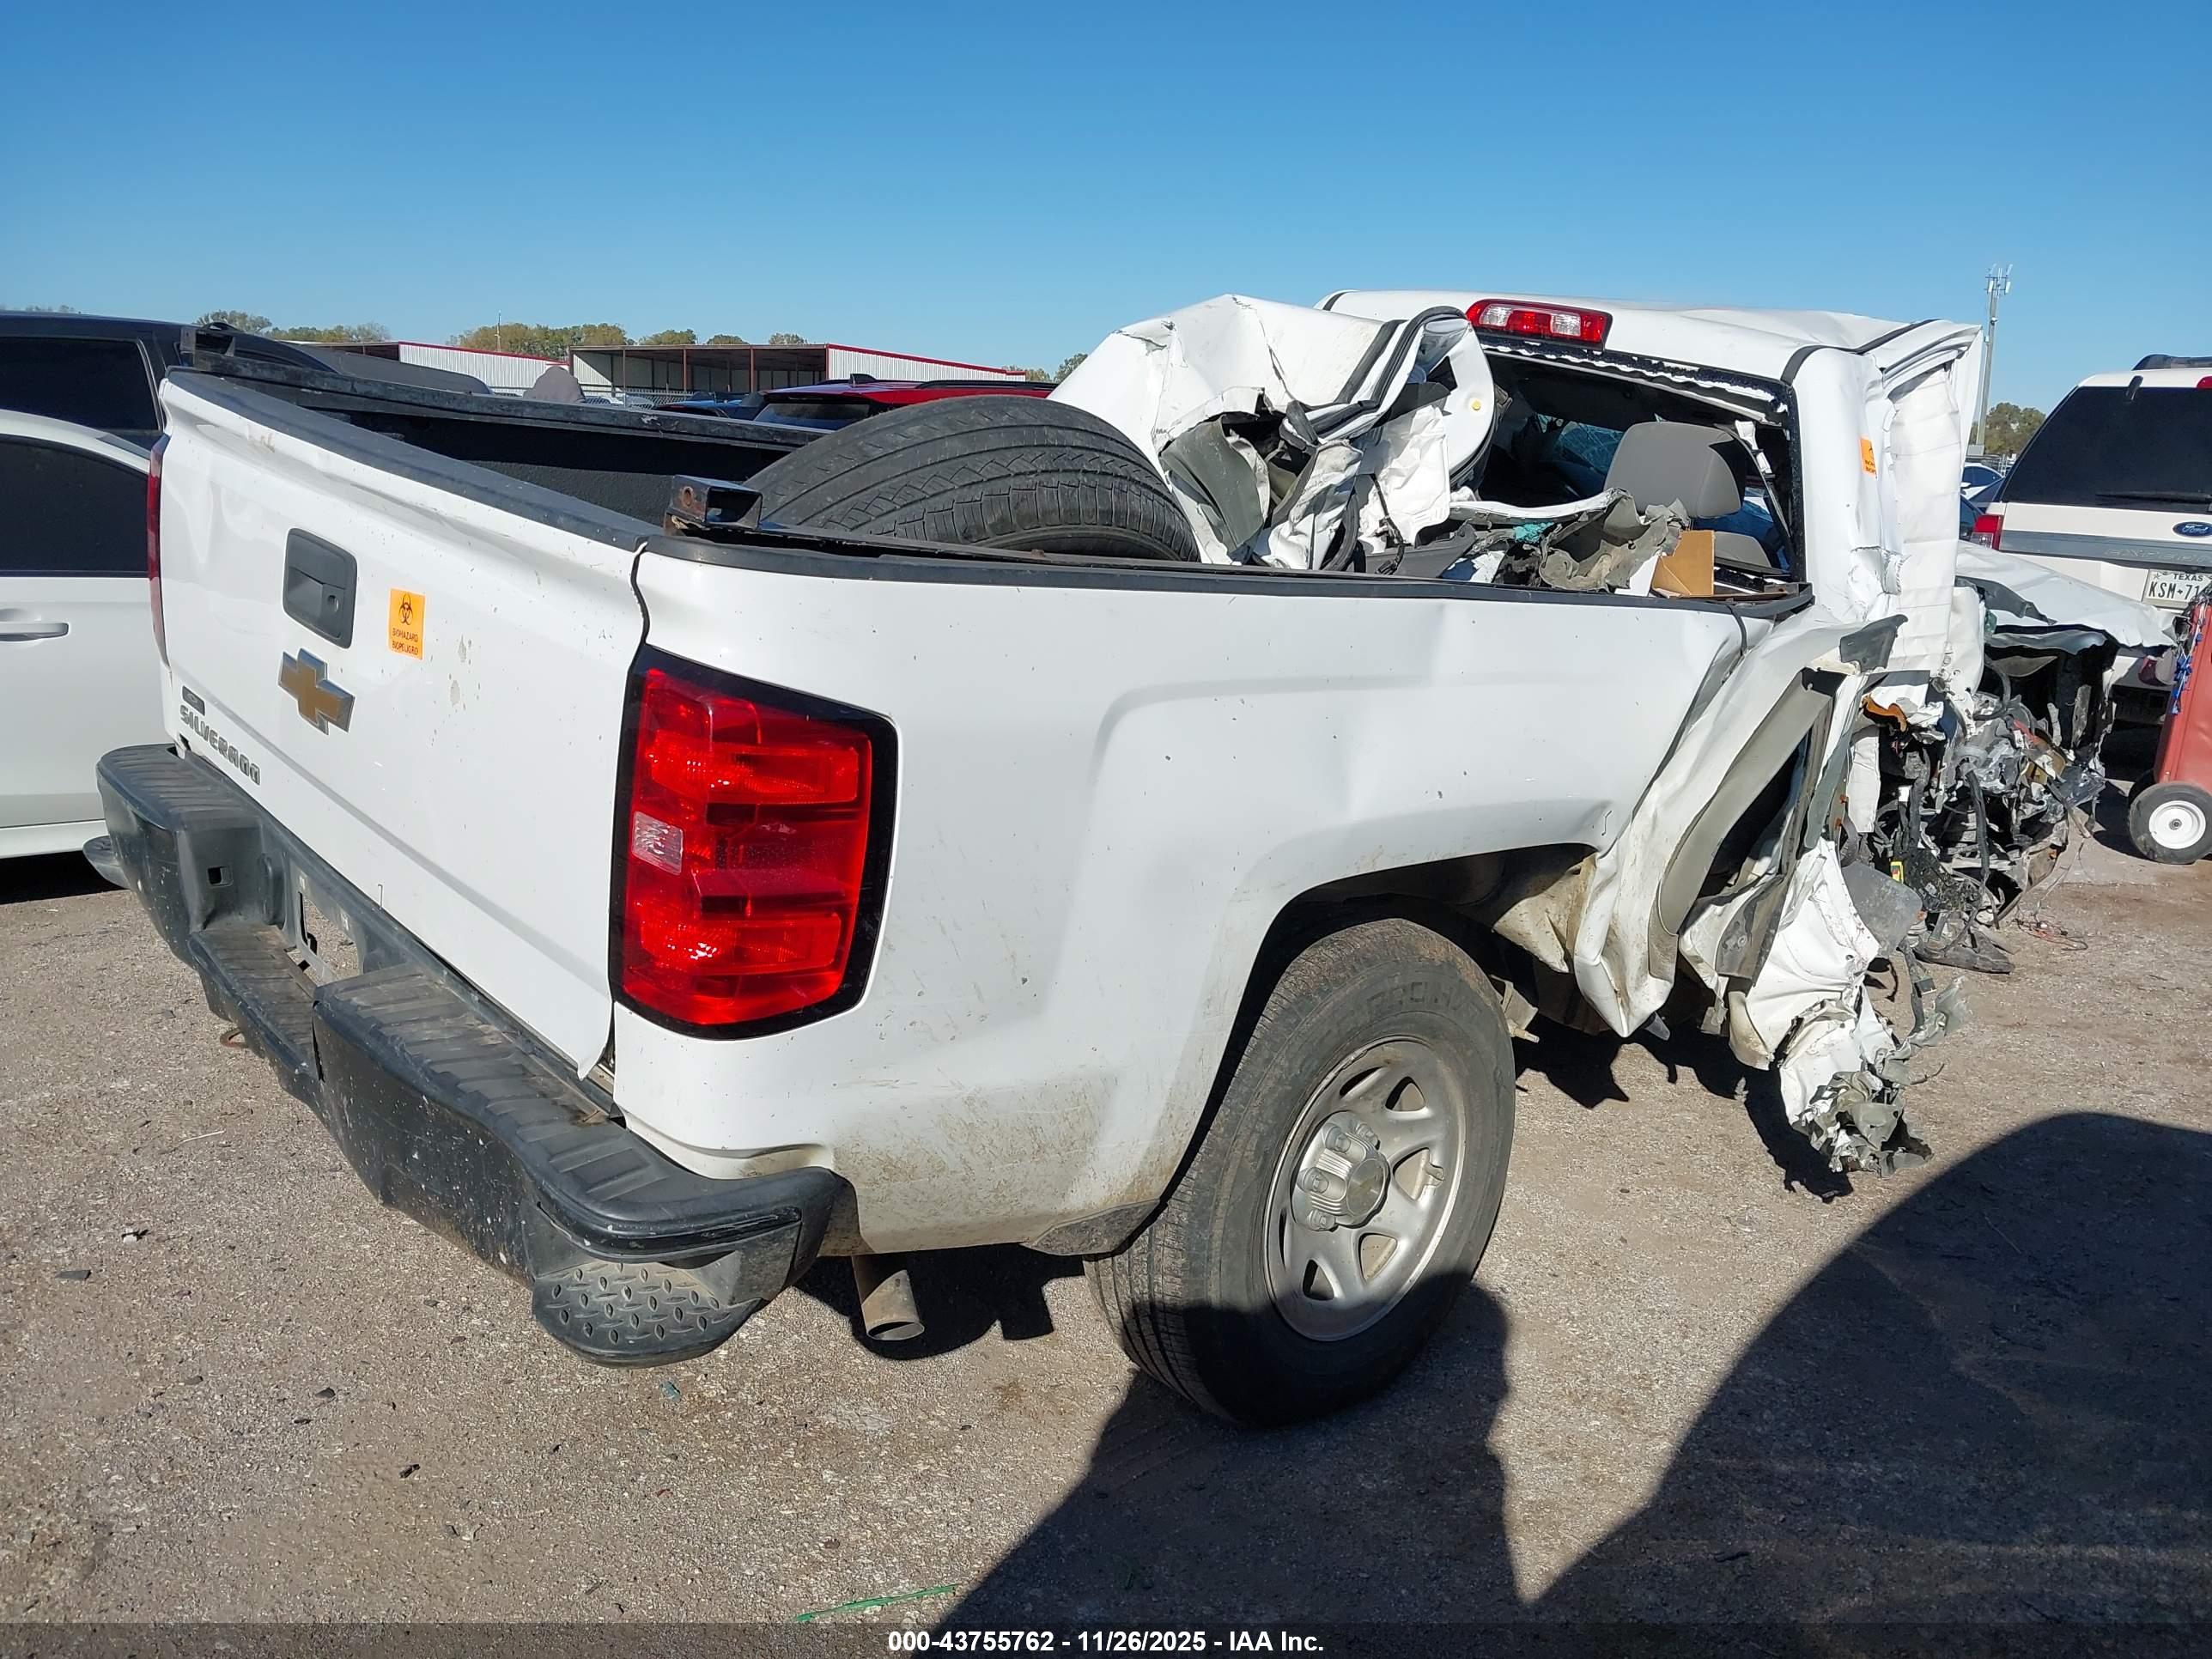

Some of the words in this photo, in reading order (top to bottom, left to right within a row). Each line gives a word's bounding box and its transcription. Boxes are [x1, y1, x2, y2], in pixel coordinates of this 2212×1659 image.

[2182, 522, 2209, 534] Ford
[2173, 573, 2203, 582] TEXAS
[392, 627, 419, 643] BIOHAZARD
[179, 704, 261, 786] SILVERADO
